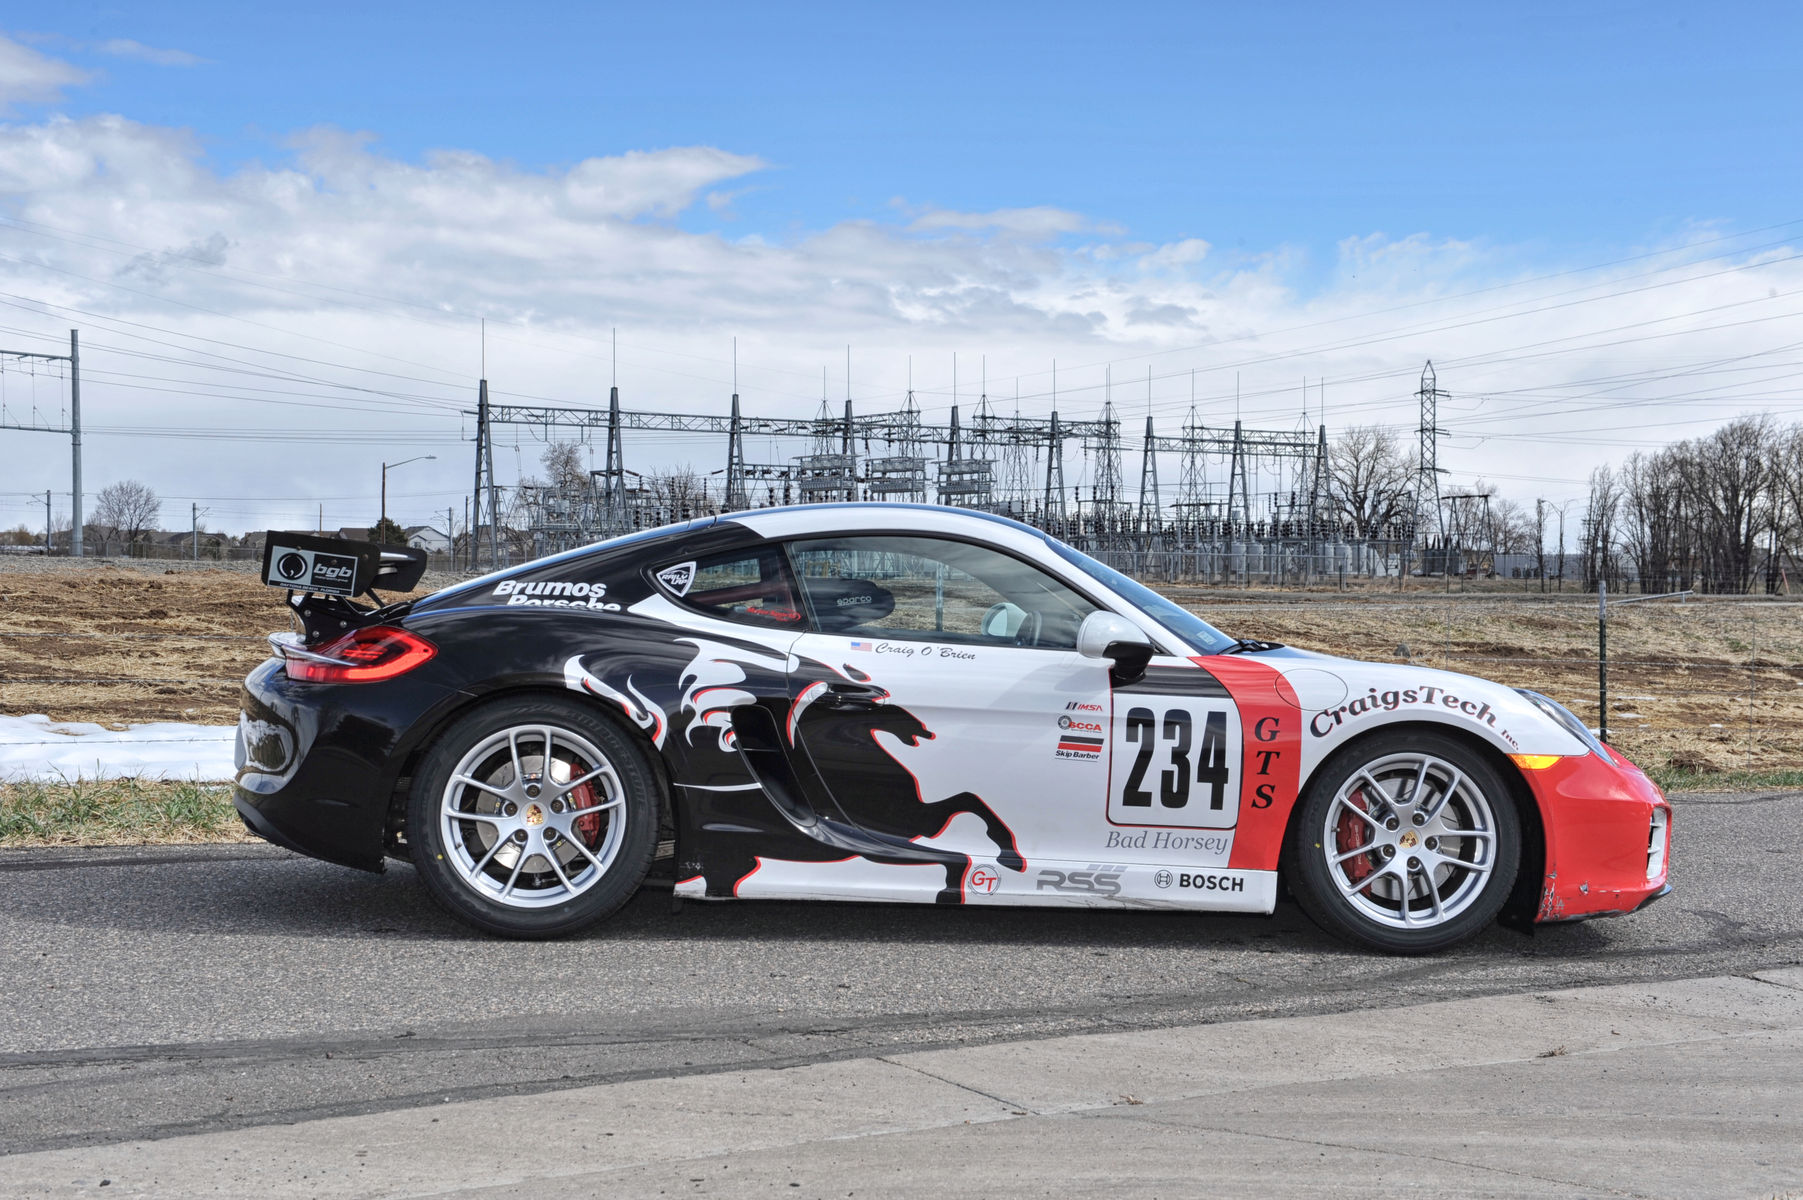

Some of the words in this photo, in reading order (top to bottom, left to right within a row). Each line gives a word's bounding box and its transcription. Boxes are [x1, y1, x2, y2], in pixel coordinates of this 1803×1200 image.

[314, 563, 353, 578] bgb
[492, 580, 607, 598] Brumos
[837, 596, 872, 606] sparco
[875, 642, 914, 657] Craig
[1077, 703, 1103, 711] IMSA
[1069, 721, 1102, 731] SCCA
[1310, 686, 1497, 738] CraigsTech
[1501, 729, 1519, 750] Inc.
[1056, 750, 1073, 758] Skip
[1073, 751, 1100, 760] Barber
[1122, 707, 1229, 811] 234
[1105, 831, 1148, 849] Bad
[1151, 832, 1229, 855] Horsey
[971, 870, 997, 892] GT
[1036, 870, 1128, 895] RSS
[1179, 873, 1245, 893] BOSCH
